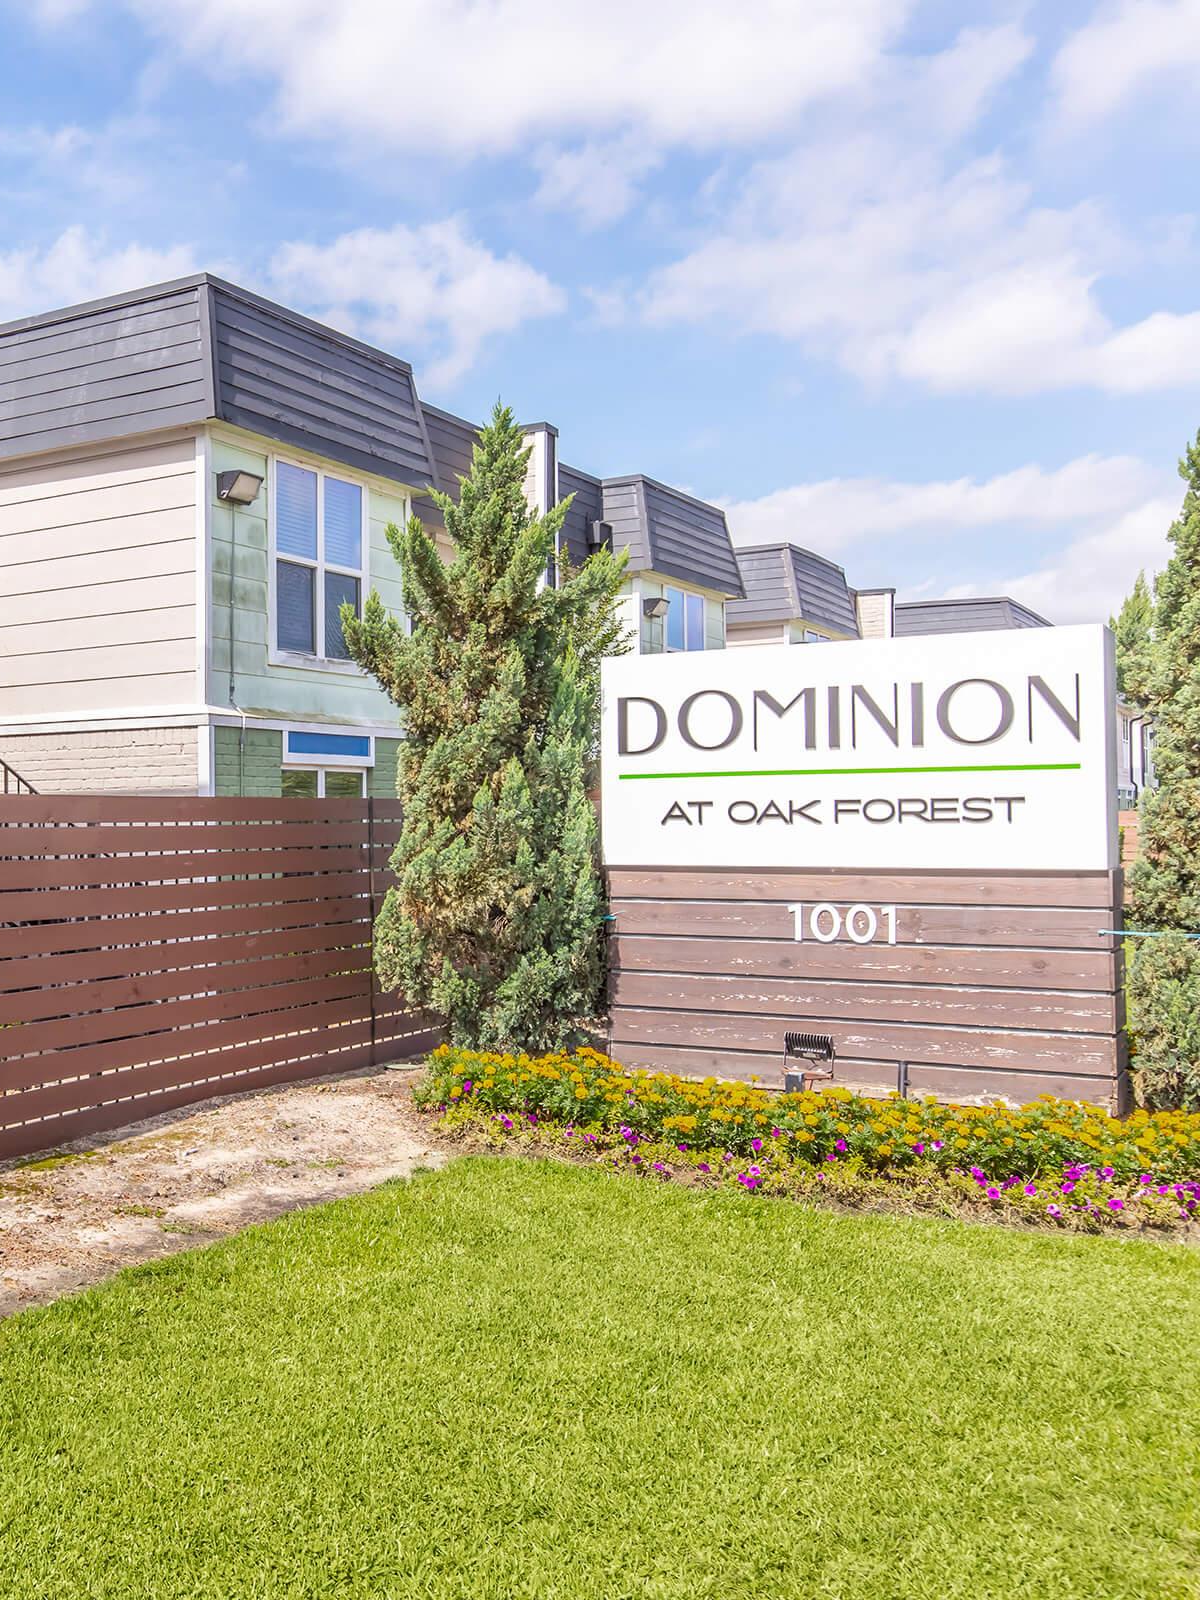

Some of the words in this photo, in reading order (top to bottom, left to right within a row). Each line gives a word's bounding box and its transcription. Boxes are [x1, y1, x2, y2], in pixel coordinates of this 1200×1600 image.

[616, 673, 1081, 757] DOMINION
[661, 801, 714, 826] AT
[727, 799, 823, 826] OAK
[834, 796, 1026, 825] FOREST
[786, 903, 897, 946] 1001
